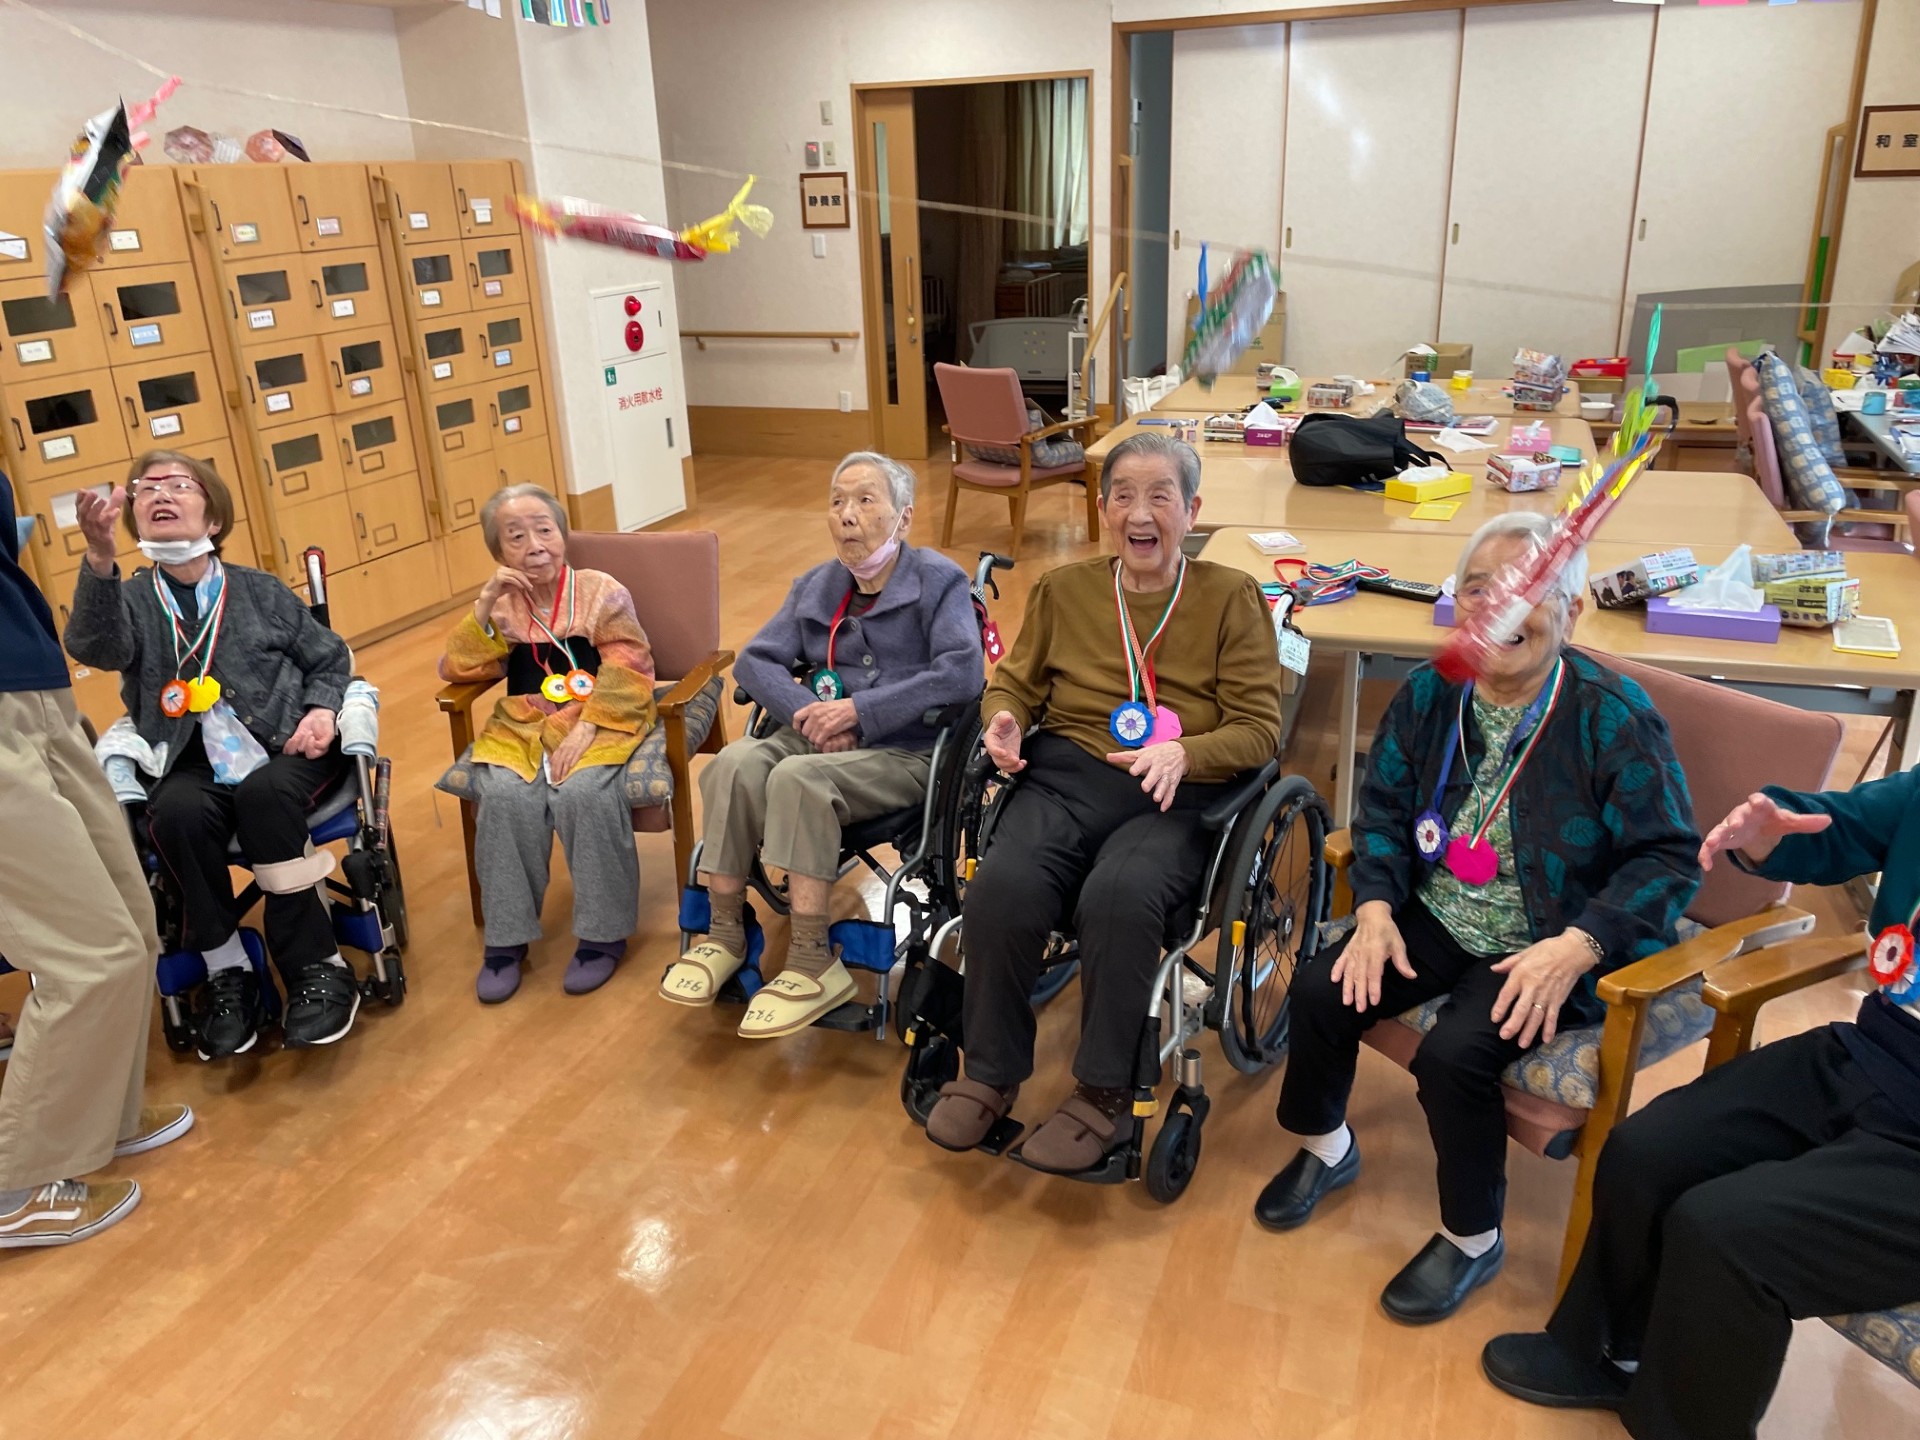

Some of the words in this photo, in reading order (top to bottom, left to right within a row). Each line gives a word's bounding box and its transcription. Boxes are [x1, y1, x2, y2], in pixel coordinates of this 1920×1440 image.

[1876, 134, 1918, 148] 和室
[808, 195, 841, 206] 静養室
